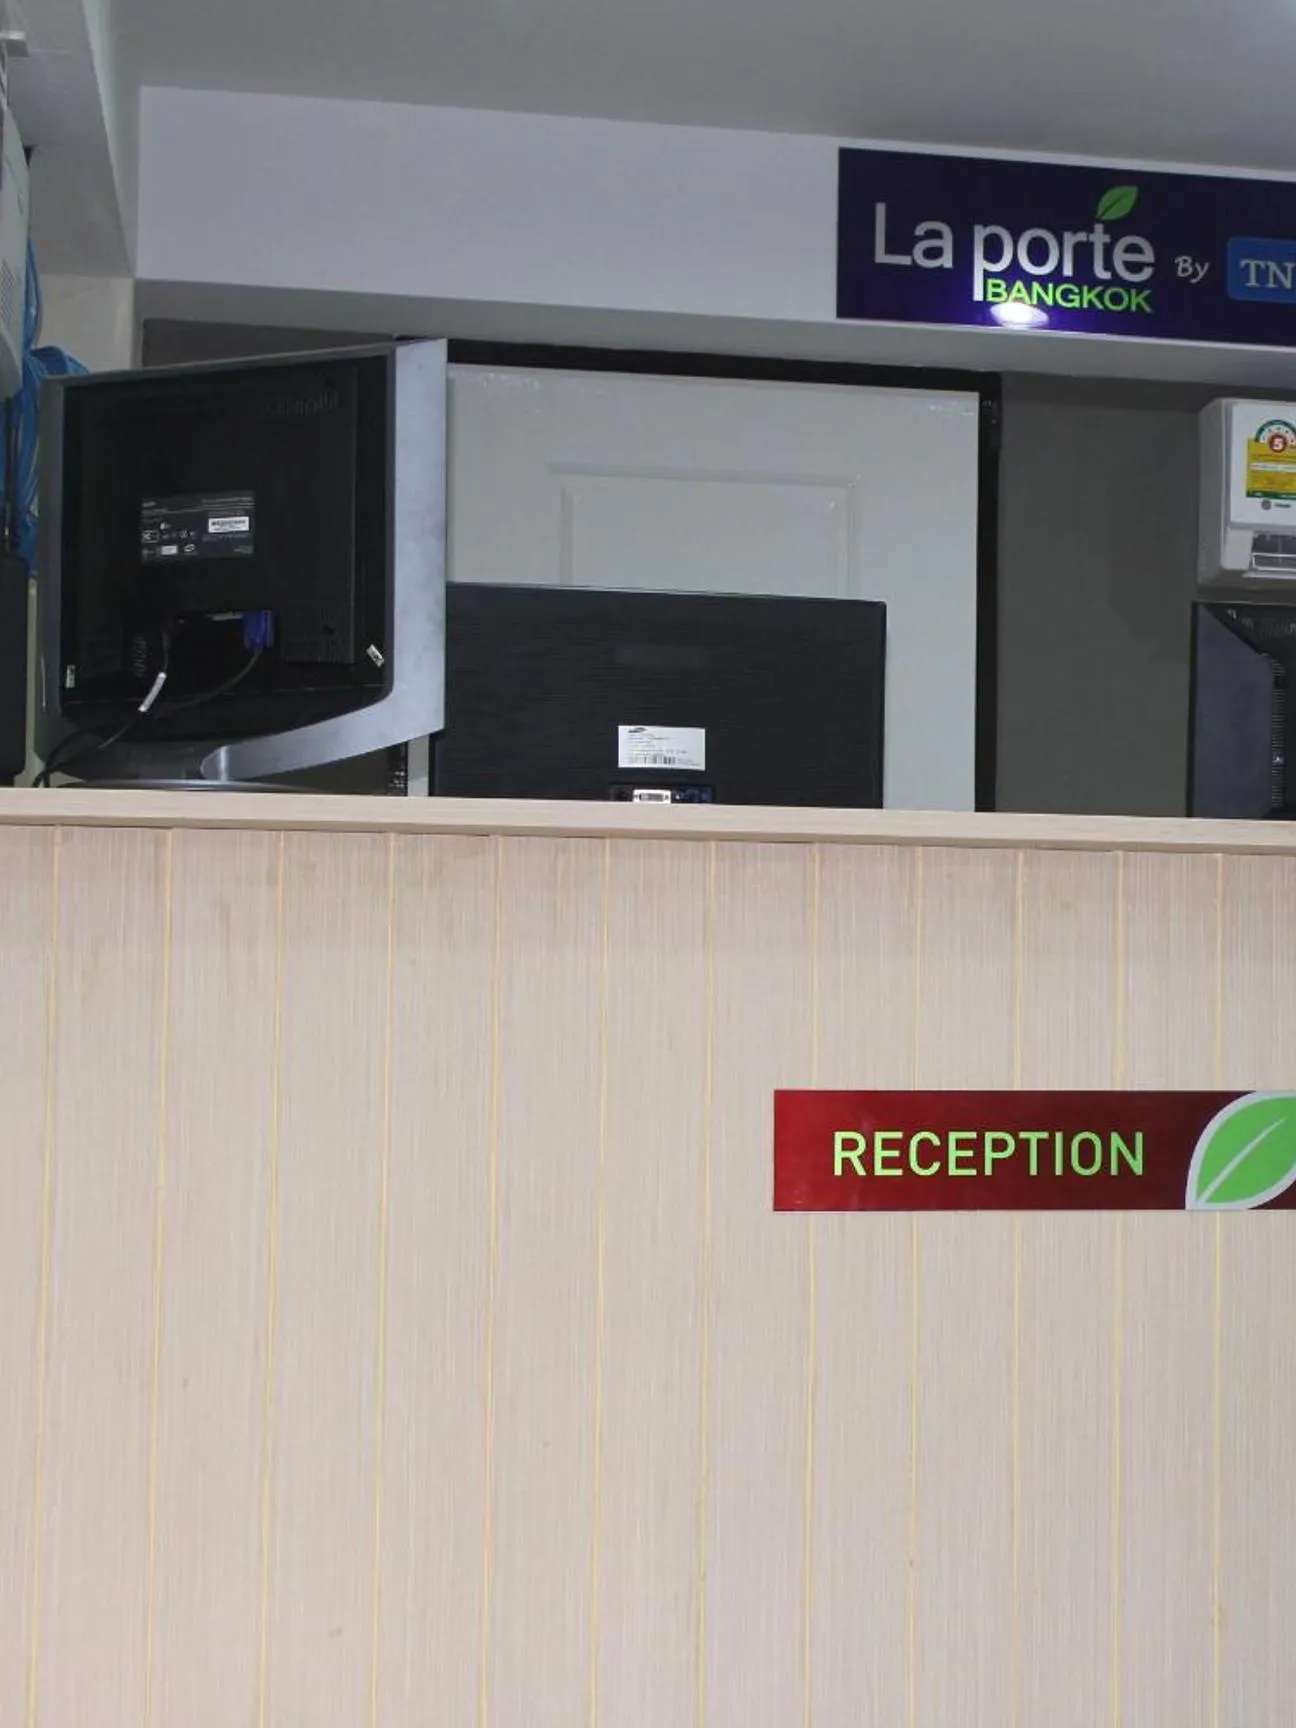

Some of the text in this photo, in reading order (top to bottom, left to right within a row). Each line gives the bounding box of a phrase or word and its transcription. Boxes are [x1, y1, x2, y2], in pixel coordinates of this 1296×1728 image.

[874, 201, 1209, 302] La porte By
[986, 278, 1153, 314] BANGKOK
[833, 1131, 1144, 1177] RECEPTION
